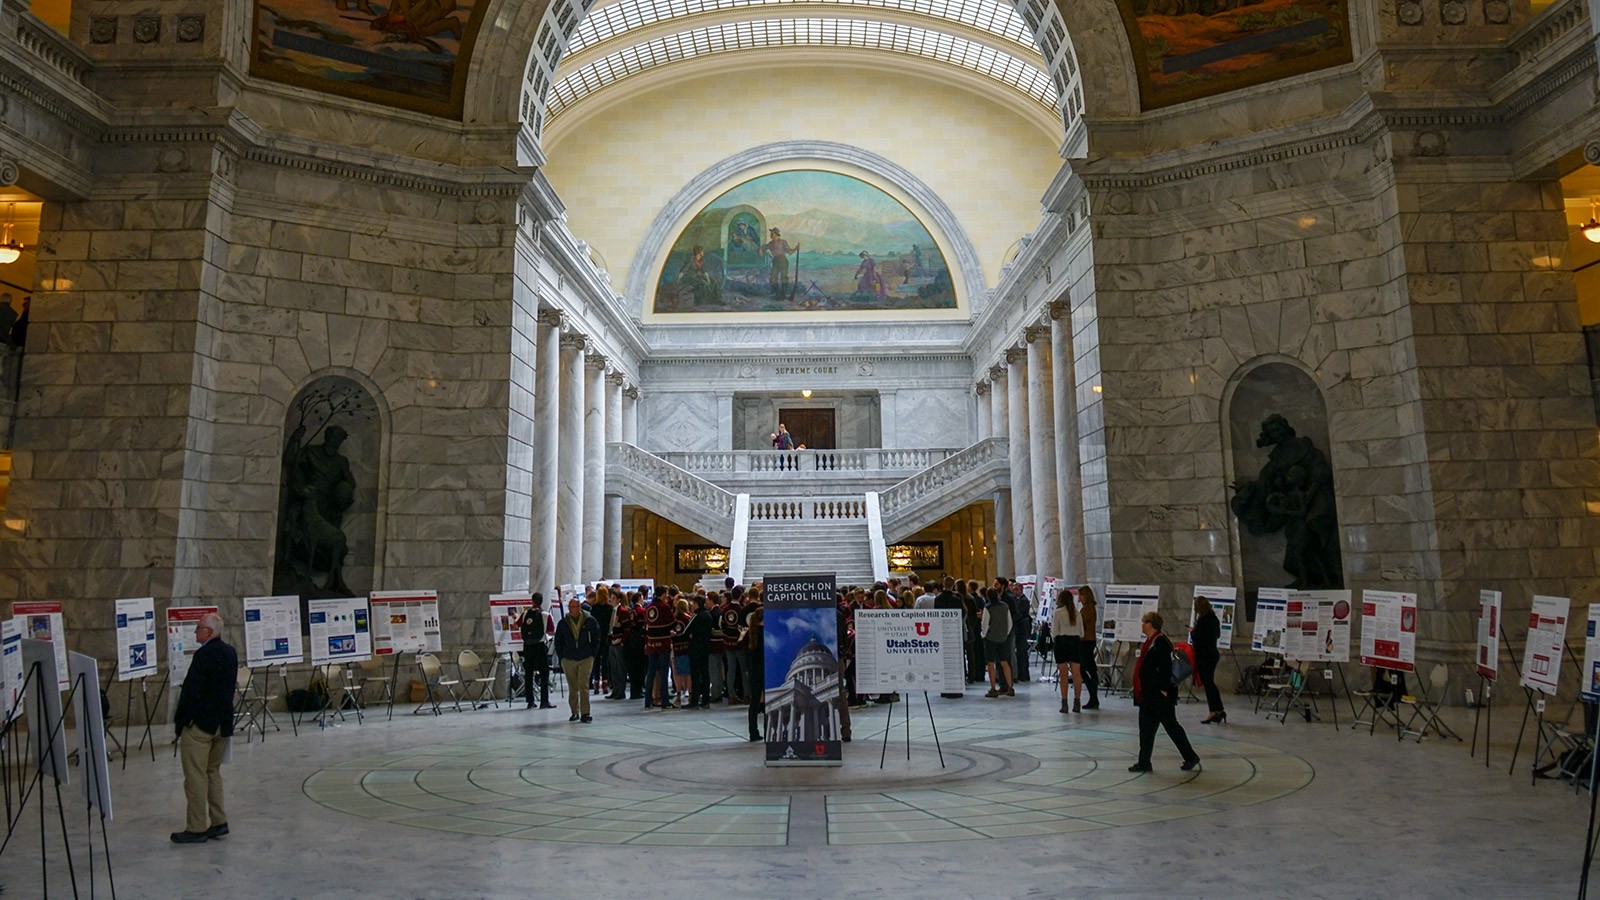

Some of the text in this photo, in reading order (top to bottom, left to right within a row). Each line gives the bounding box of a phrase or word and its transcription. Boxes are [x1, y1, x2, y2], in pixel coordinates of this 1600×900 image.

[775, 366, 838, 375] SUPREME COURT
[767, 582, 832, 592] RESEARCH ON
[767, 592, 832, 602] CAPITOL HILL
[901, 611, 926, 619] Capitol
[915, 622, 930, 636] U
[886, 639, 940, 648] UtahState
